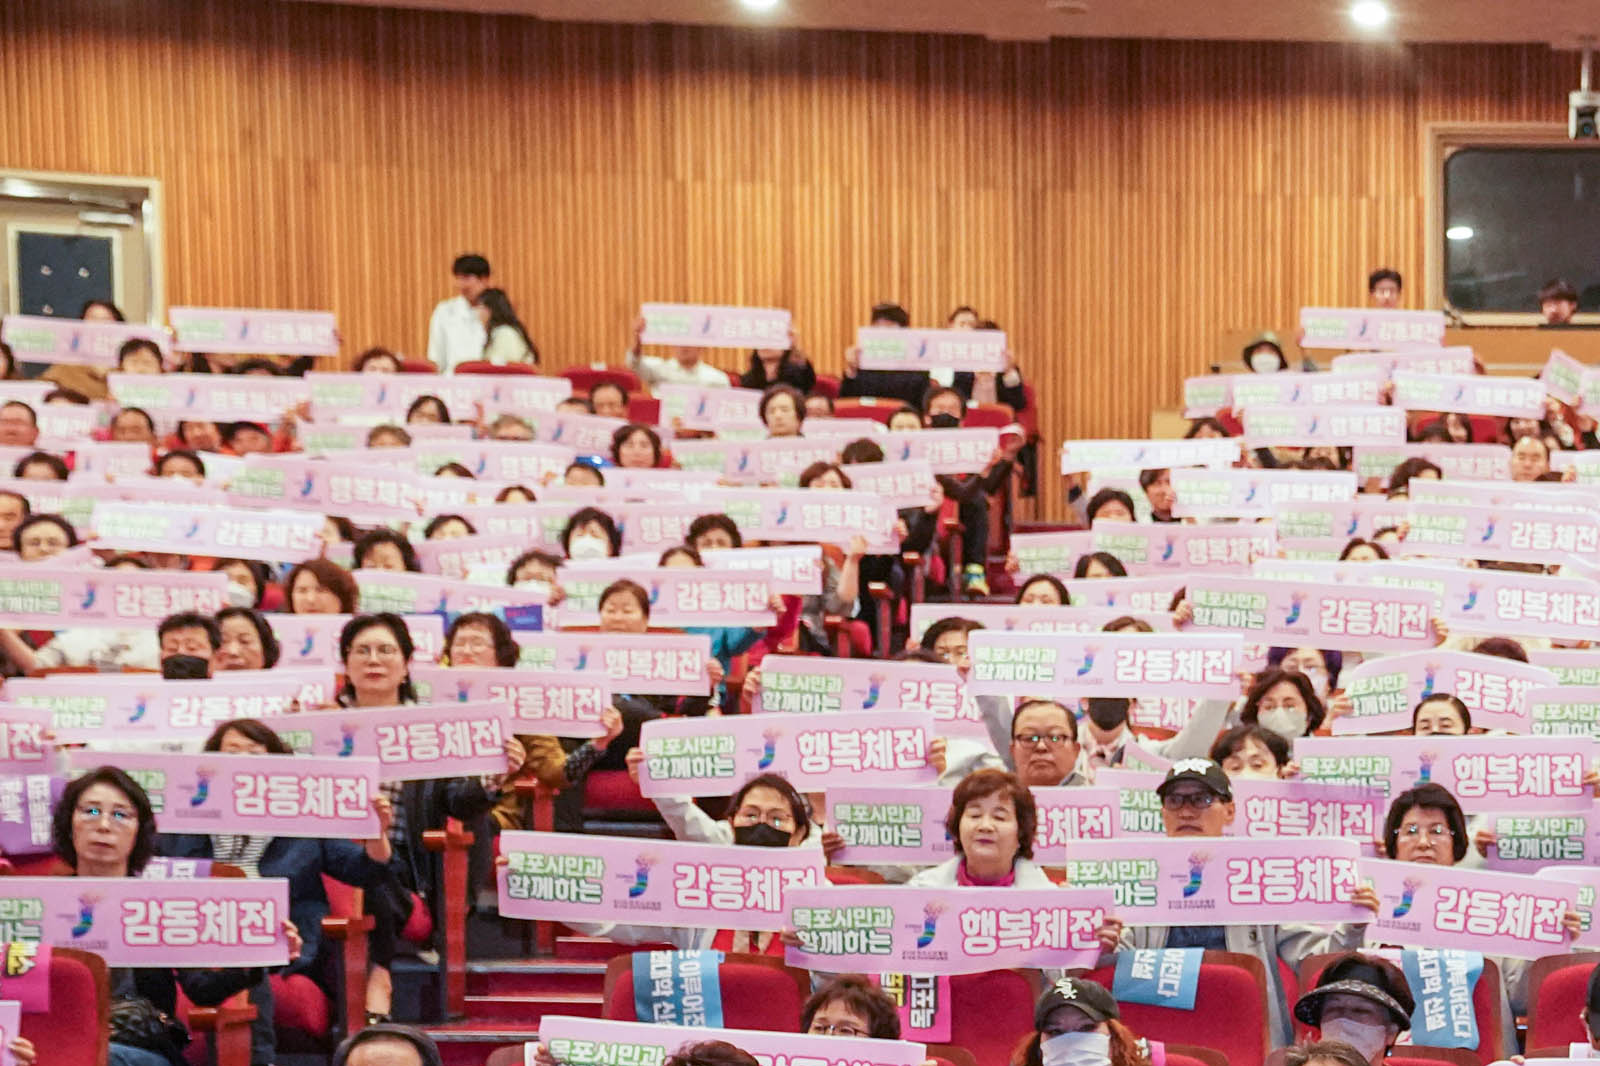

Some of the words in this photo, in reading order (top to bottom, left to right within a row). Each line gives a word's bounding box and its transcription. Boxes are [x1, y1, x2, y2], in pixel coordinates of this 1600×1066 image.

[1317, 597, 1429, 640] 감동체전
[1495, 586, 1600, 626] 행복체전
[604, 647, 702, 682] 행복체전
[1113, 647, 1234, 684] 감동체전
[377, 717, 504, 764] 감동체전
[646, 734, 736, 759] 목포시민과
[797, 726, 930, 775] 행복체전
[646, 754, 736, 780] 함께하는
[1301, 755, 1391, 778] 목포시민과
[1452, 752, 1585, 798] 행복체전
[231, 770, 371, 821] 감동체전
[832, 802, 923, 826] 목포시민과
[835, 822, 923, 849] 함께하는
[1246, 796, 1377, 844] 행복체전
[505, 850, 606, 881] 목포시민과
[1497, 836, 1585, 861] 함께하는
[506, 874, 604, 904] 함께하는
[1225, 856, 1362, 905] 감동체전
[120, 898, 278, 949] 감동체전
[790, 904, 896, 931] 목포시민과
[958, 903, 1105, 955] 행복체전
[1434, 885, 1570, 944] 감동체전
[796, 928, 894, 956] 함께하는
